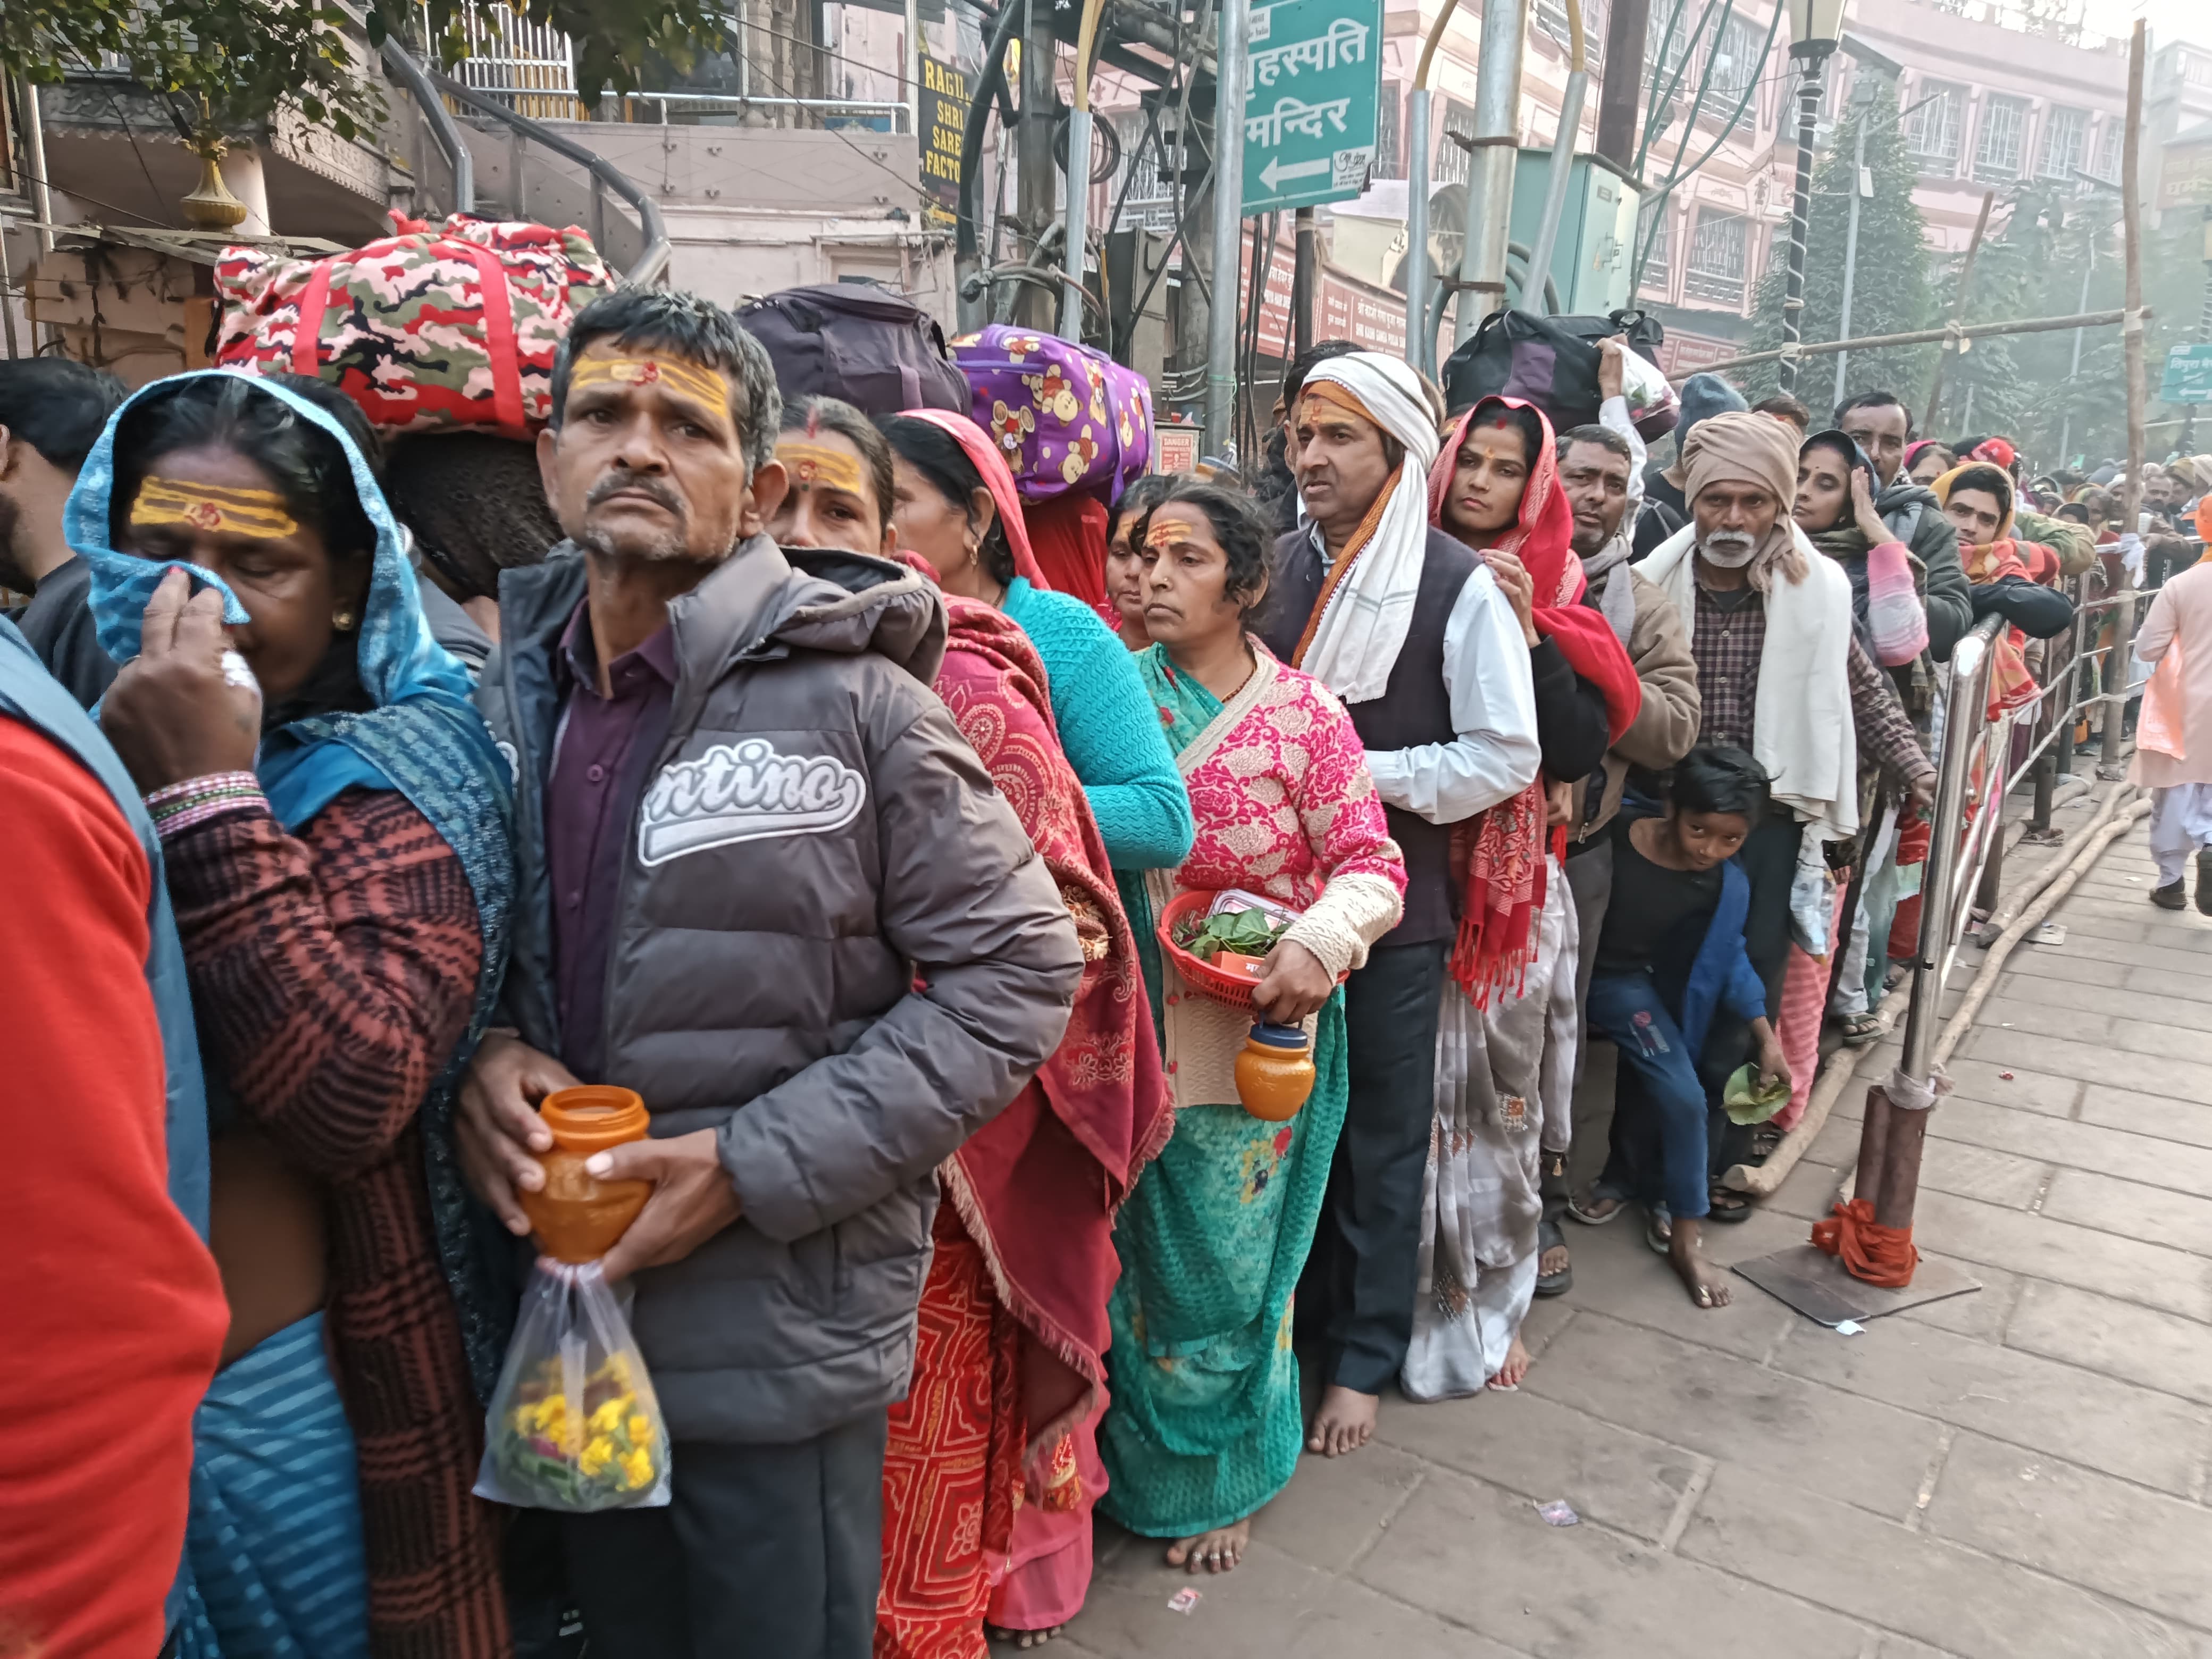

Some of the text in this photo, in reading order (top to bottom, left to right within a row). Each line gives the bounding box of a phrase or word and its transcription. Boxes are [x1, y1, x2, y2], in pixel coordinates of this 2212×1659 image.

[937, 99, 963, 131] SHRI
[1245, 96, 1351, 148] मन्दिर
[932, 124, 962, 157] SARE
[926, 149, 960, 185] FACTO
[647, 741, 845, 822] ntino
